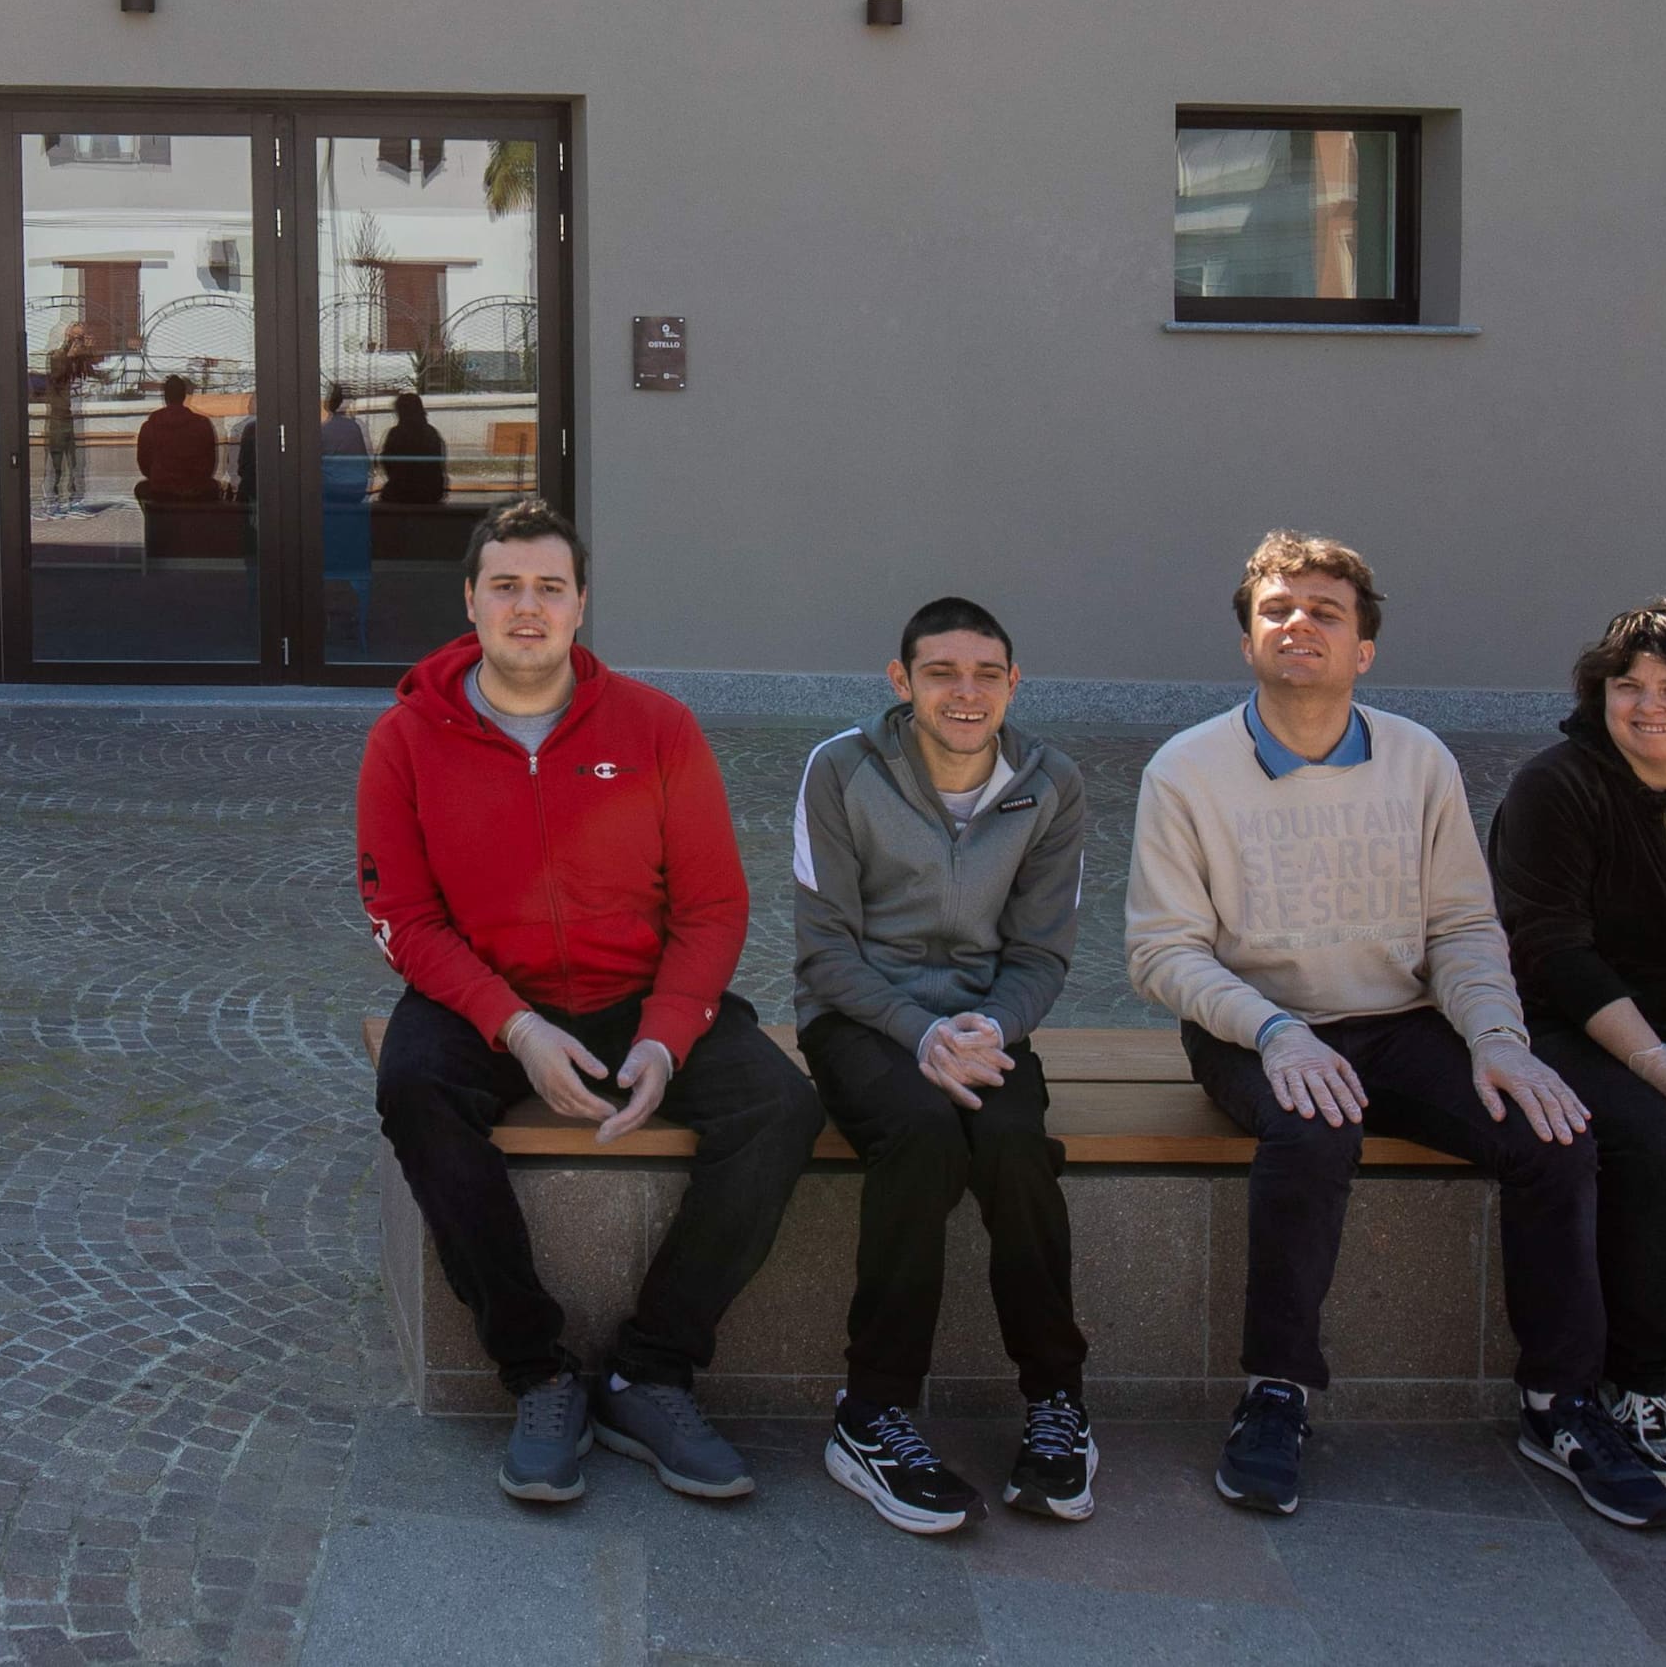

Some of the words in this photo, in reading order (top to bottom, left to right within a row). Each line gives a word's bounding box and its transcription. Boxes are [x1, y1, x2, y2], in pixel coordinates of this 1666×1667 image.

[648, 341, 680, 349] OSTELLO
[1235, 797, 1417, 842] MOUNTAIN
[1240, 836, 1420, 885] SEARCH
[1244, 880, 1421, 931] RESCUE
